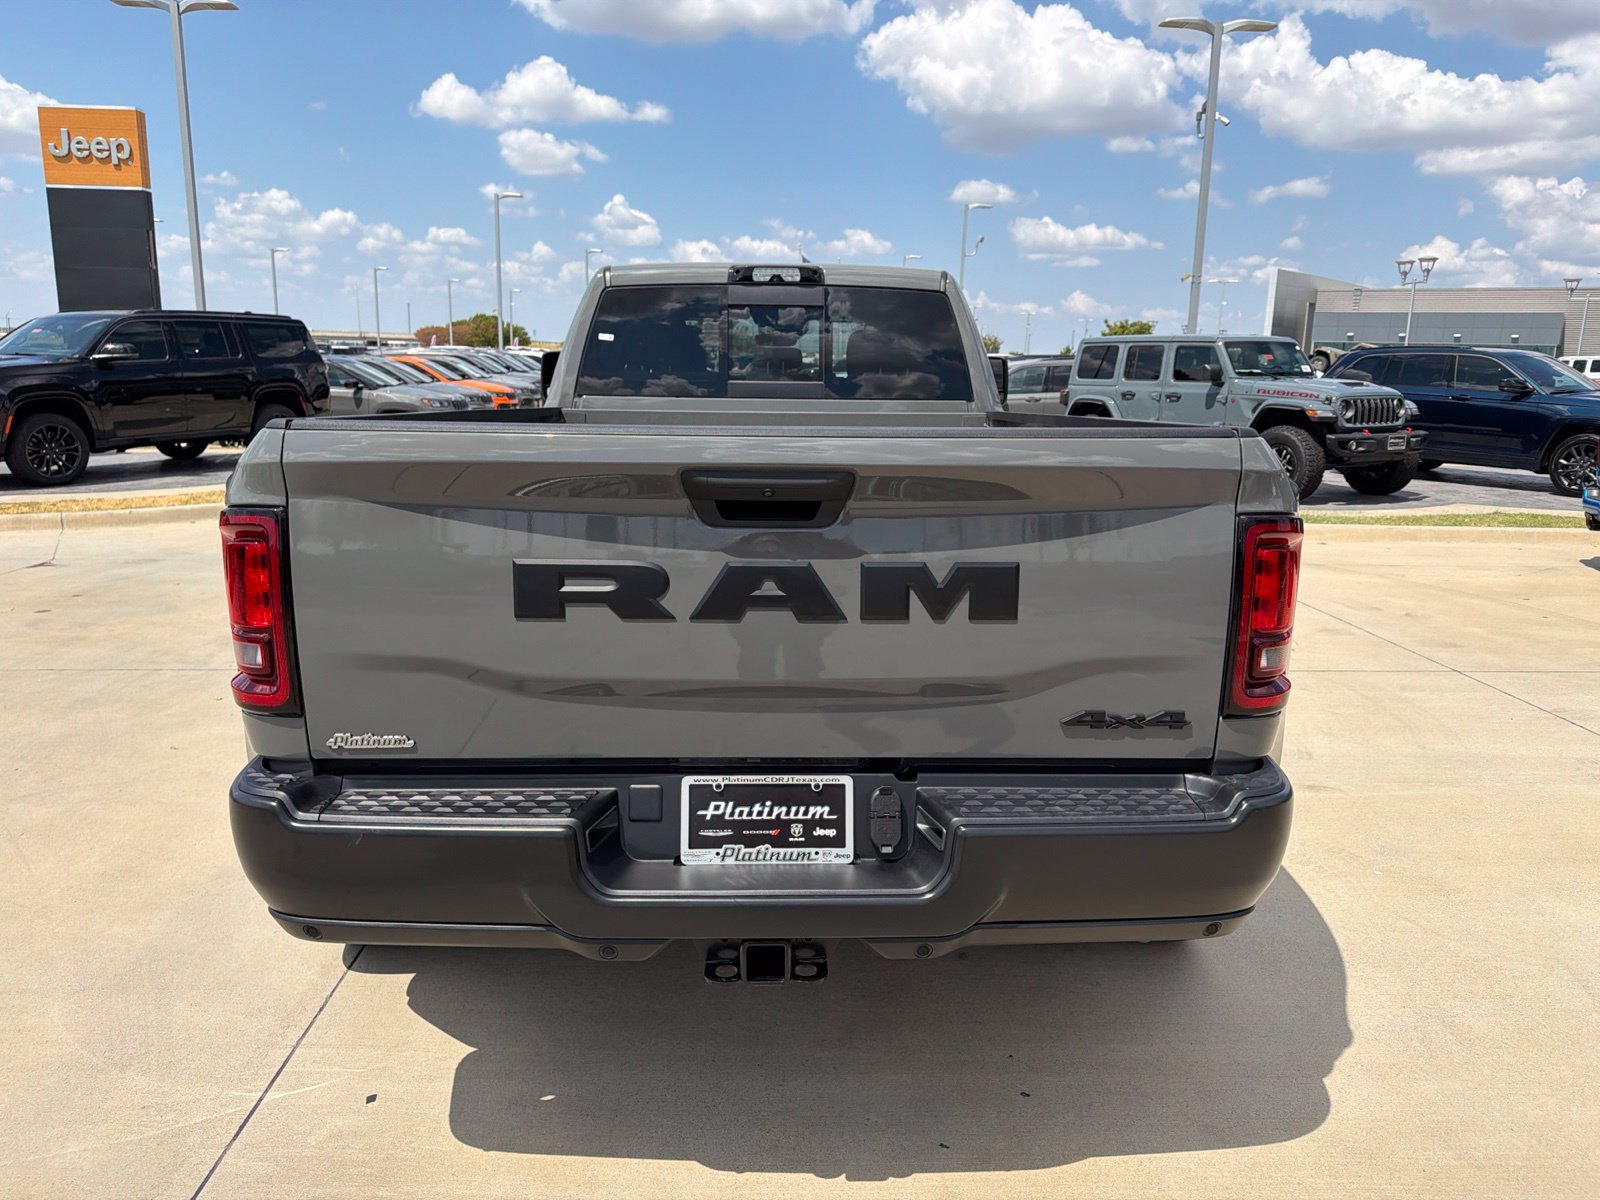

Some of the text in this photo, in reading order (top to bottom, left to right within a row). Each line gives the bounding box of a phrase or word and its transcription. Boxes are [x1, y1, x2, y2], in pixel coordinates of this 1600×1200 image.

[47, 128, 131, 165] Jeep
[1256, 388, 1320, 399] RUBICON
[512, 559, 1020, 623] RAM
[326, 732, 415, 749] Platinum
[697, 801, 838, 820] Platinum
[813, 827, 837, 837] Jeep
[720, 845, 818, 863] Platinum
